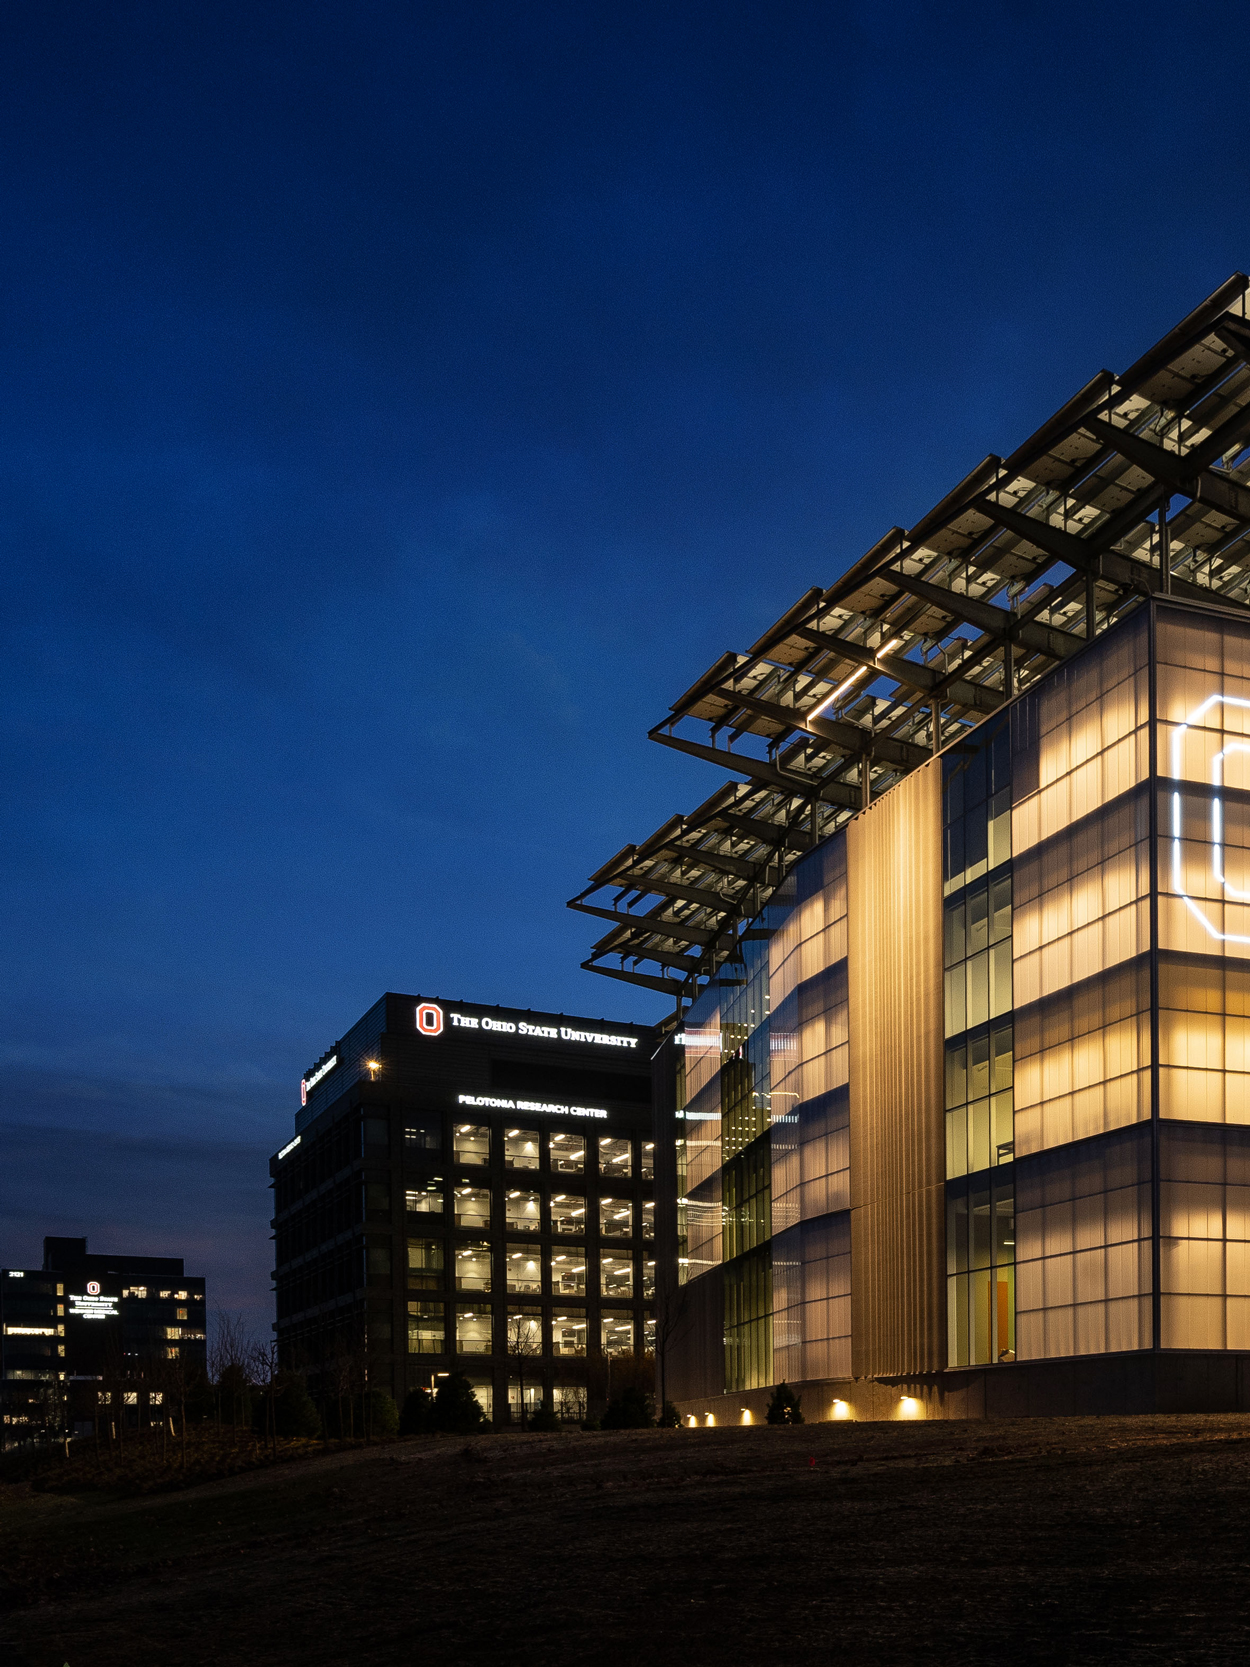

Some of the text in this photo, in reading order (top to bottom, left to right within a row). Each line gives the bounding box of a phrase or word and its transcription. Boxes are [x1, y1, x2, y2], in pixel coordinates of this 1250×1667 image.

[457, 1094, 608, 1119] PELOTONIA RESEARCH CENTER
